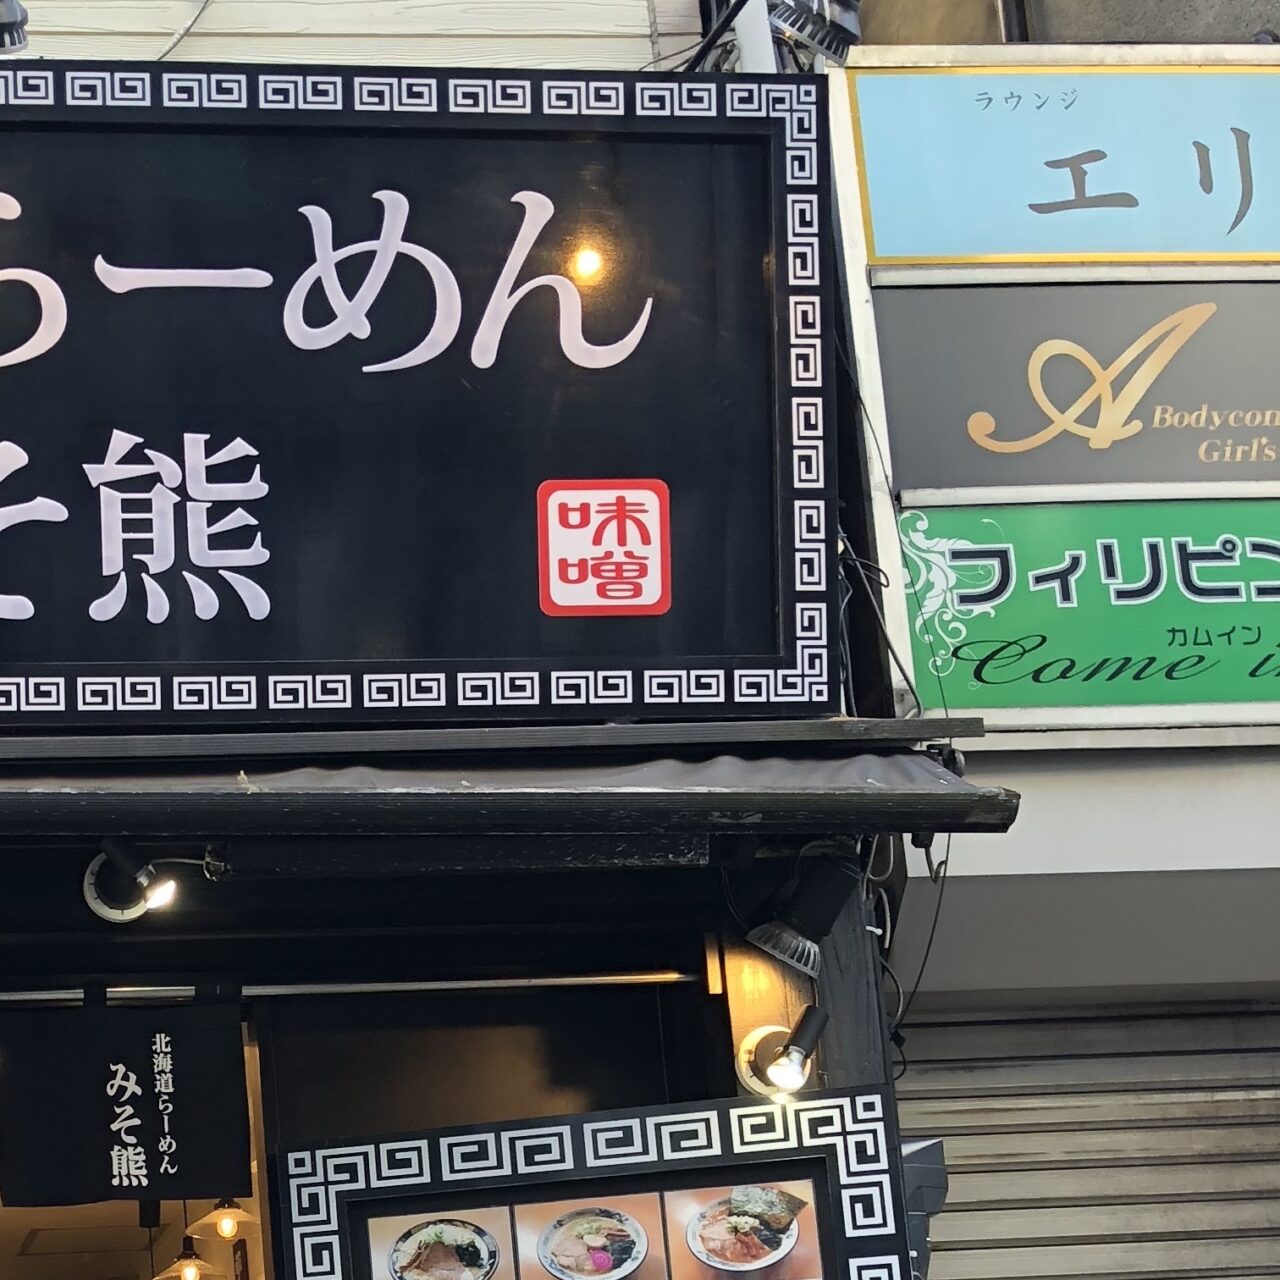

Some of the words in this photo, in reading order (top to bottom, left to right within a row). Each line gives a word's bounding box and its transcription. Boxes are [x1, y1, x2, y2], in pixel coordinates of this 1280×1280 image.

[975, 89, 1080, 112] ラウンジ
[1028, 127, 1253, 236] エリ
[1198, 436, 1276, 463] Girl's
[951, 634, 1222, 685] Come
[1167, 626, 1262, 648] カムイン
[106, 1063, 148, 1187] みそ熊
[152, 1033, 178, 1174] 北海道らーめん
